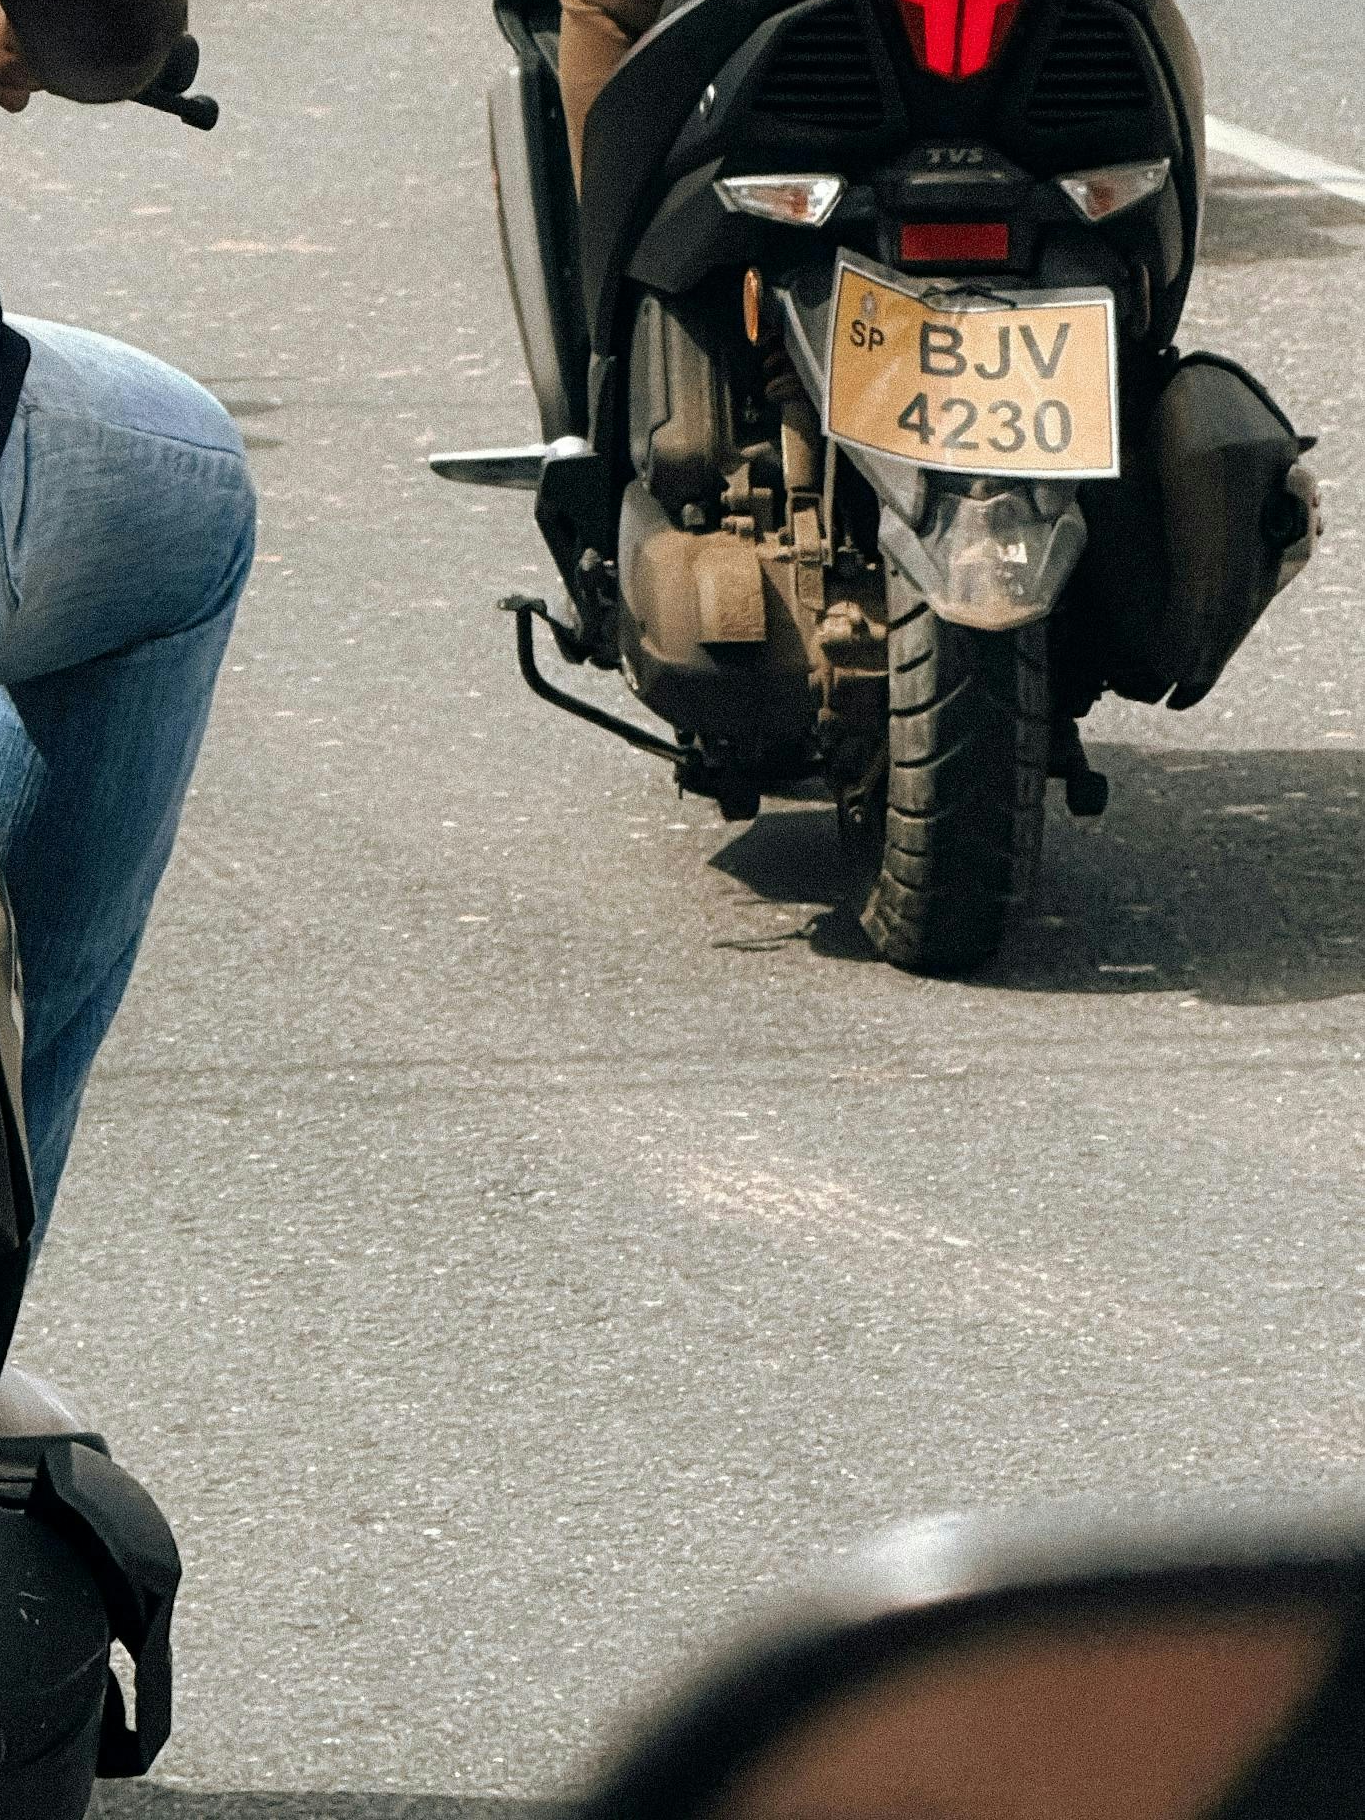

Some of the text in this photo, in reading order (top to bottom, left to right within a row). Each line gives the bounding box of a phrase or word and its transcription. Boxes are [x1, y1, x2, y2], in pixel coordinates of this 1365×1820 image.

[925, 146, 985, 165] TVS
[849, 318, 1072, 380] SP BJV
[896, 391, 1073, 454] 4230
